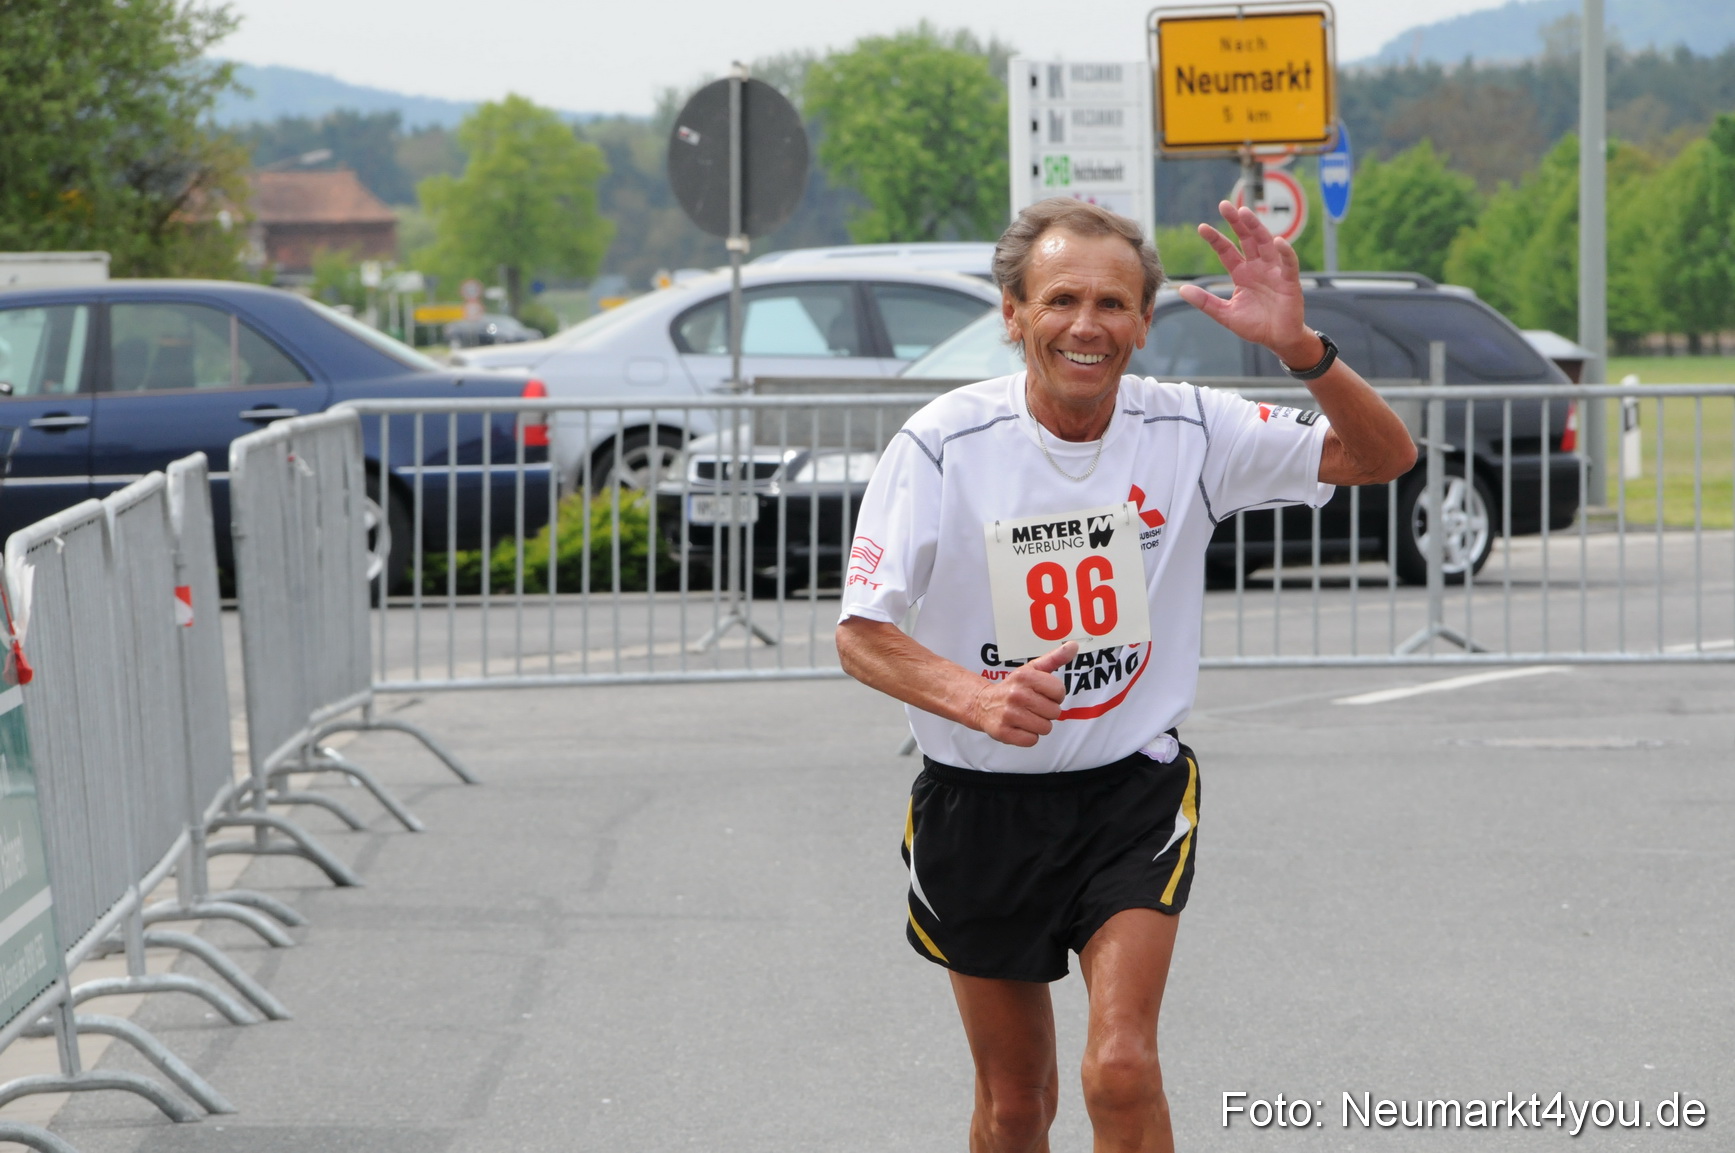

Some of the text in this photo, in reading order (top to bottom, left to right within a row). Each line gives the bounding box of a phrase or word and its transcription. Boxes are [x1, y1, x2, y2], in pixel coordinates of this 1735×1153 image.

[1219, 36, 1267, 52] Nach
[1174, 60, 1312, 95] Neumarkt
[1222, 105, 1272, 123] 5 km
[1012, 519, 1082, 543] MEYER
[1012, 536, 1084, 555] WERBUNG
[1026, 555, 1118, 641] 86
